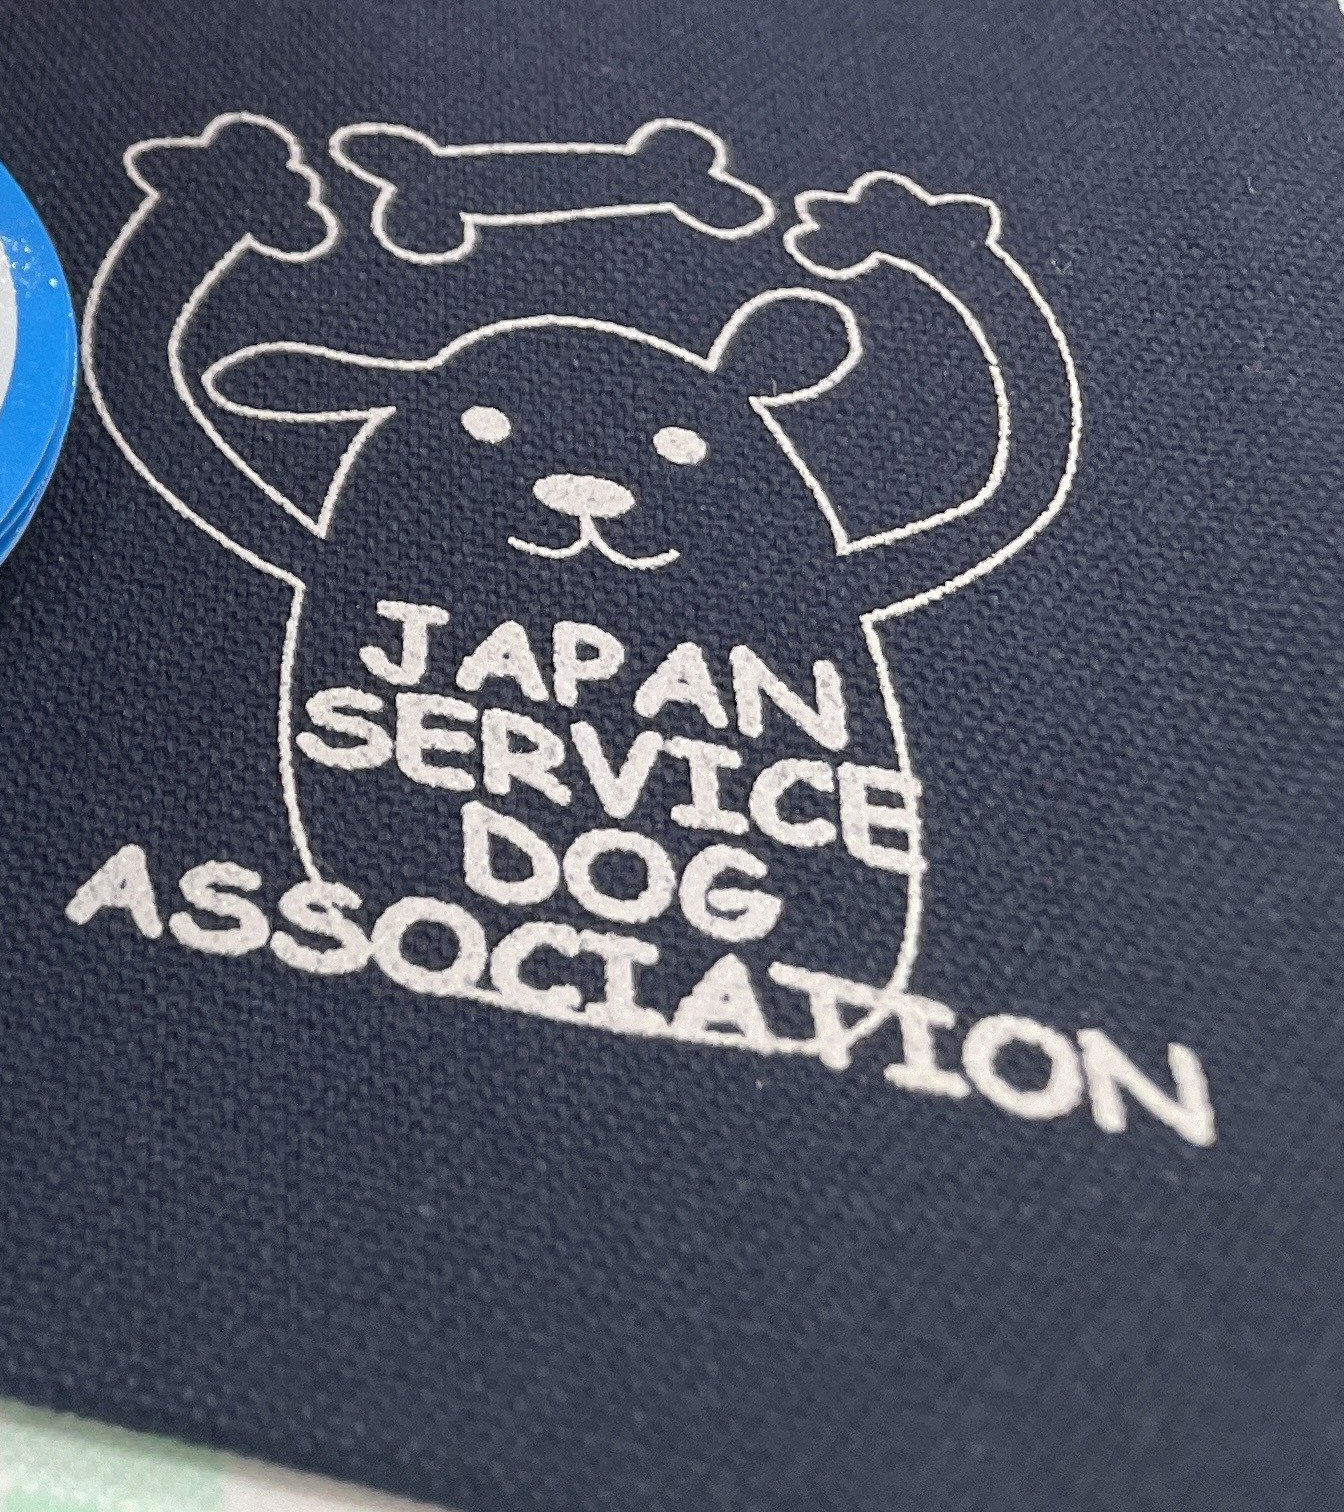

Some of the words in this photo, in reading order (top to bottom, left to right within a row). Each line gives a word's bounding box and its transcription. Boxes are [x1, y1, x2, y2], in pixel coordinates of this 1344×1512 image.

[359, 598, 850, 750] JAPAN
[296, 686, 928, 874] SERVICE
[461, 799, 784, 942] DOG
[64, 841, 1218, 1148] ASSOCIATION
